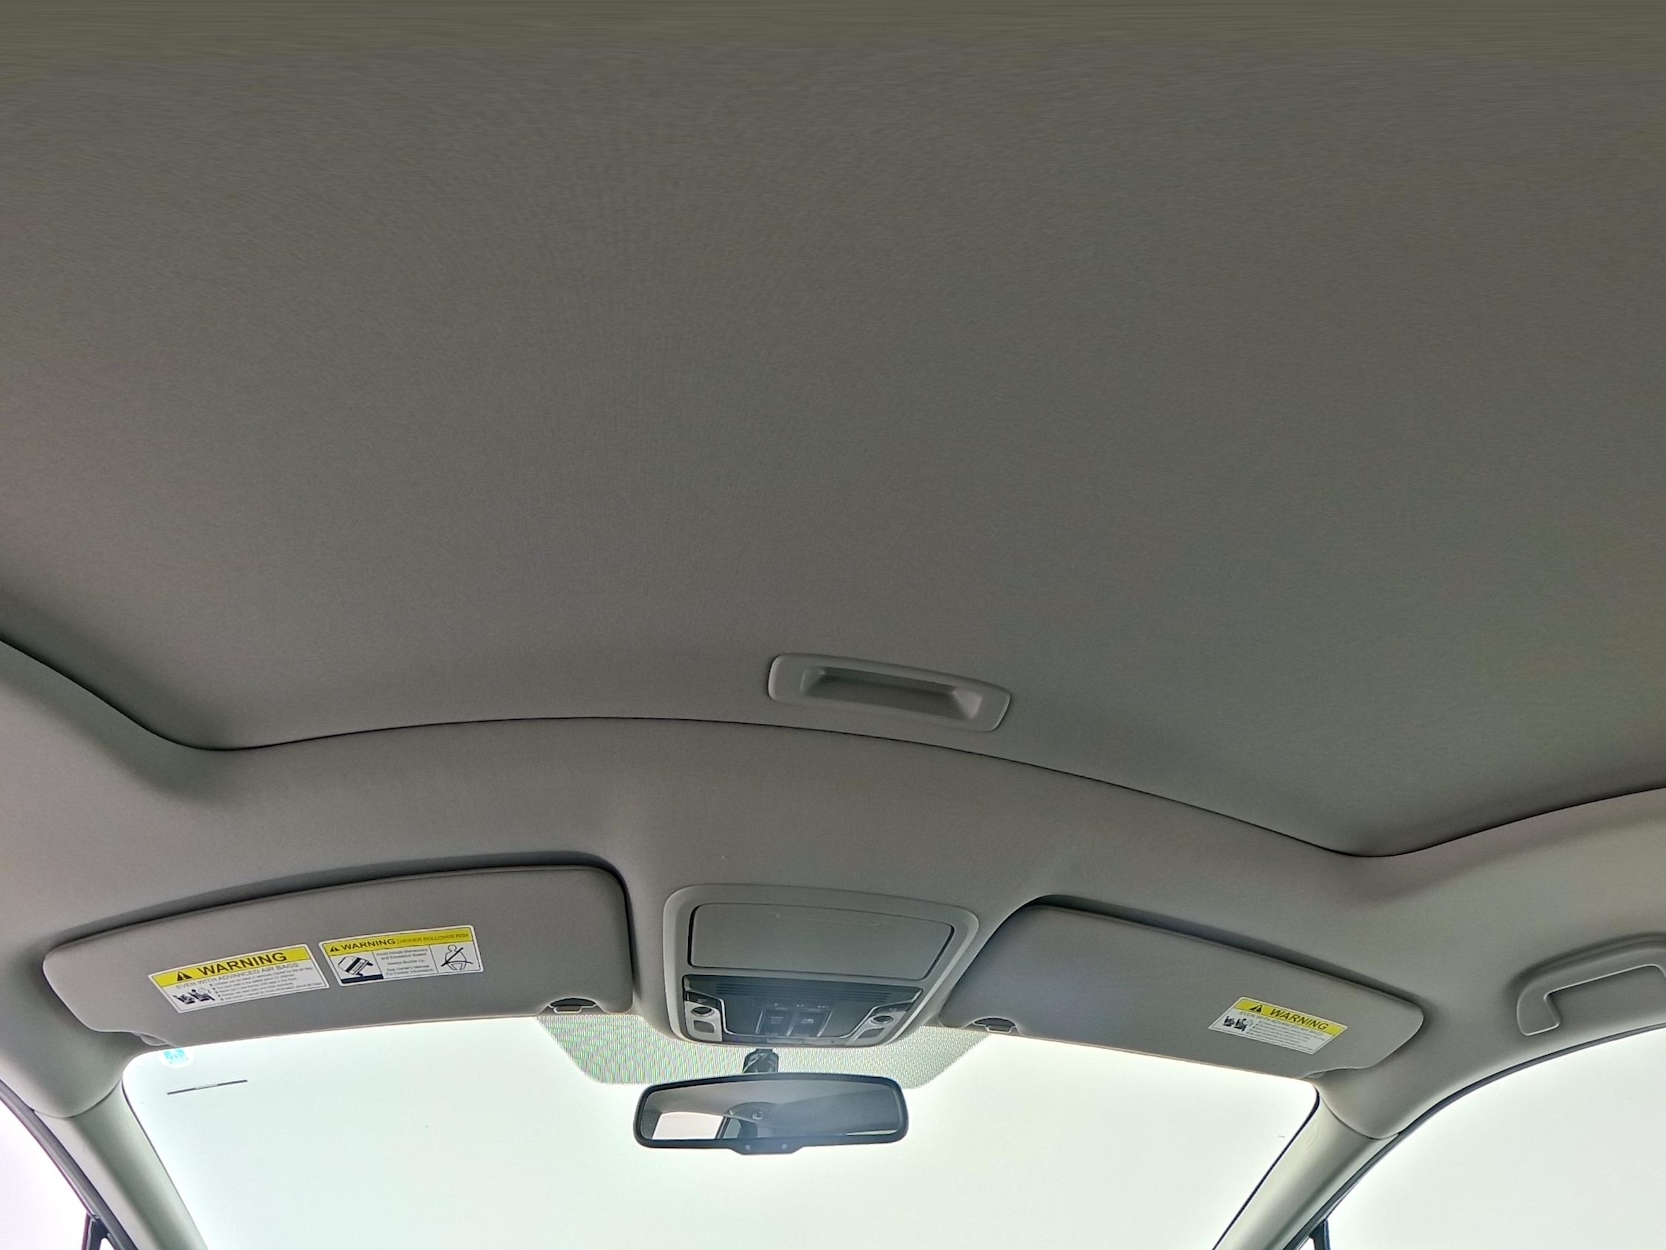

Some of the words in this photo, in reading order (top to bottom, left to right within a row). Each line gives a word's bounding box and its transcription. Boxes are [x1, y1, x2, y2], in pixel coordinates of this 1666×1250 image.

[197, 952, 287, 976] WARNING
[218, 969, 260, 981] ADVANCED
[276, 962, 299, 971] BAGS
[1269, 1008, 1329, 1031] WARNING
